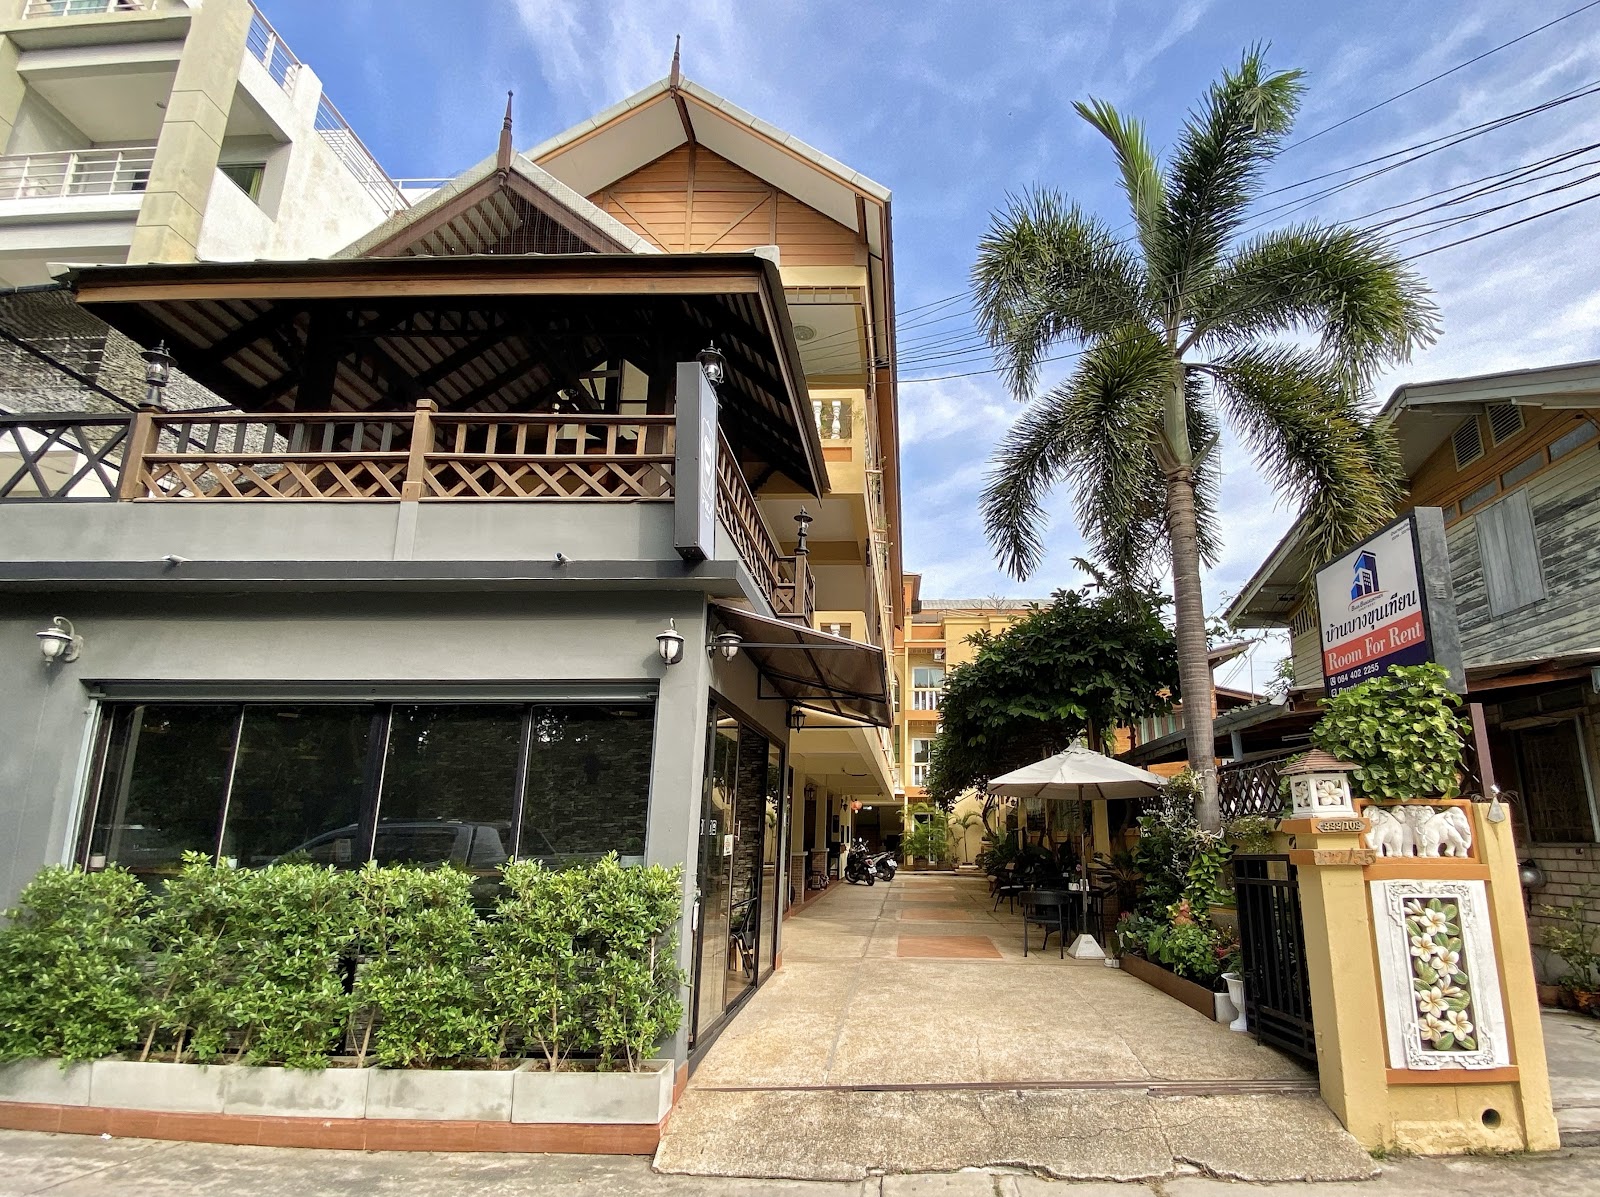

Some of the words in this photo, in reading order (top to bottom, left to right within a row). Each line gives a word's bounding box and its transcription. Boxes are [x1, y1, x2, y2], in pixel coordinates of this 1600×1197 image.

[1325, 590, 1417, 642] บ้านบางขุนเทียน
[1328, 647, 1363, 671] Room
[1365, 636, 1386, 657] For
[1388, 622, 1421, 648] Rent
[1350, 669, 1362, 680] 402
[1363, 662, 1380, 675] 2255
[1323, 820, 1361, 831] 222/102
